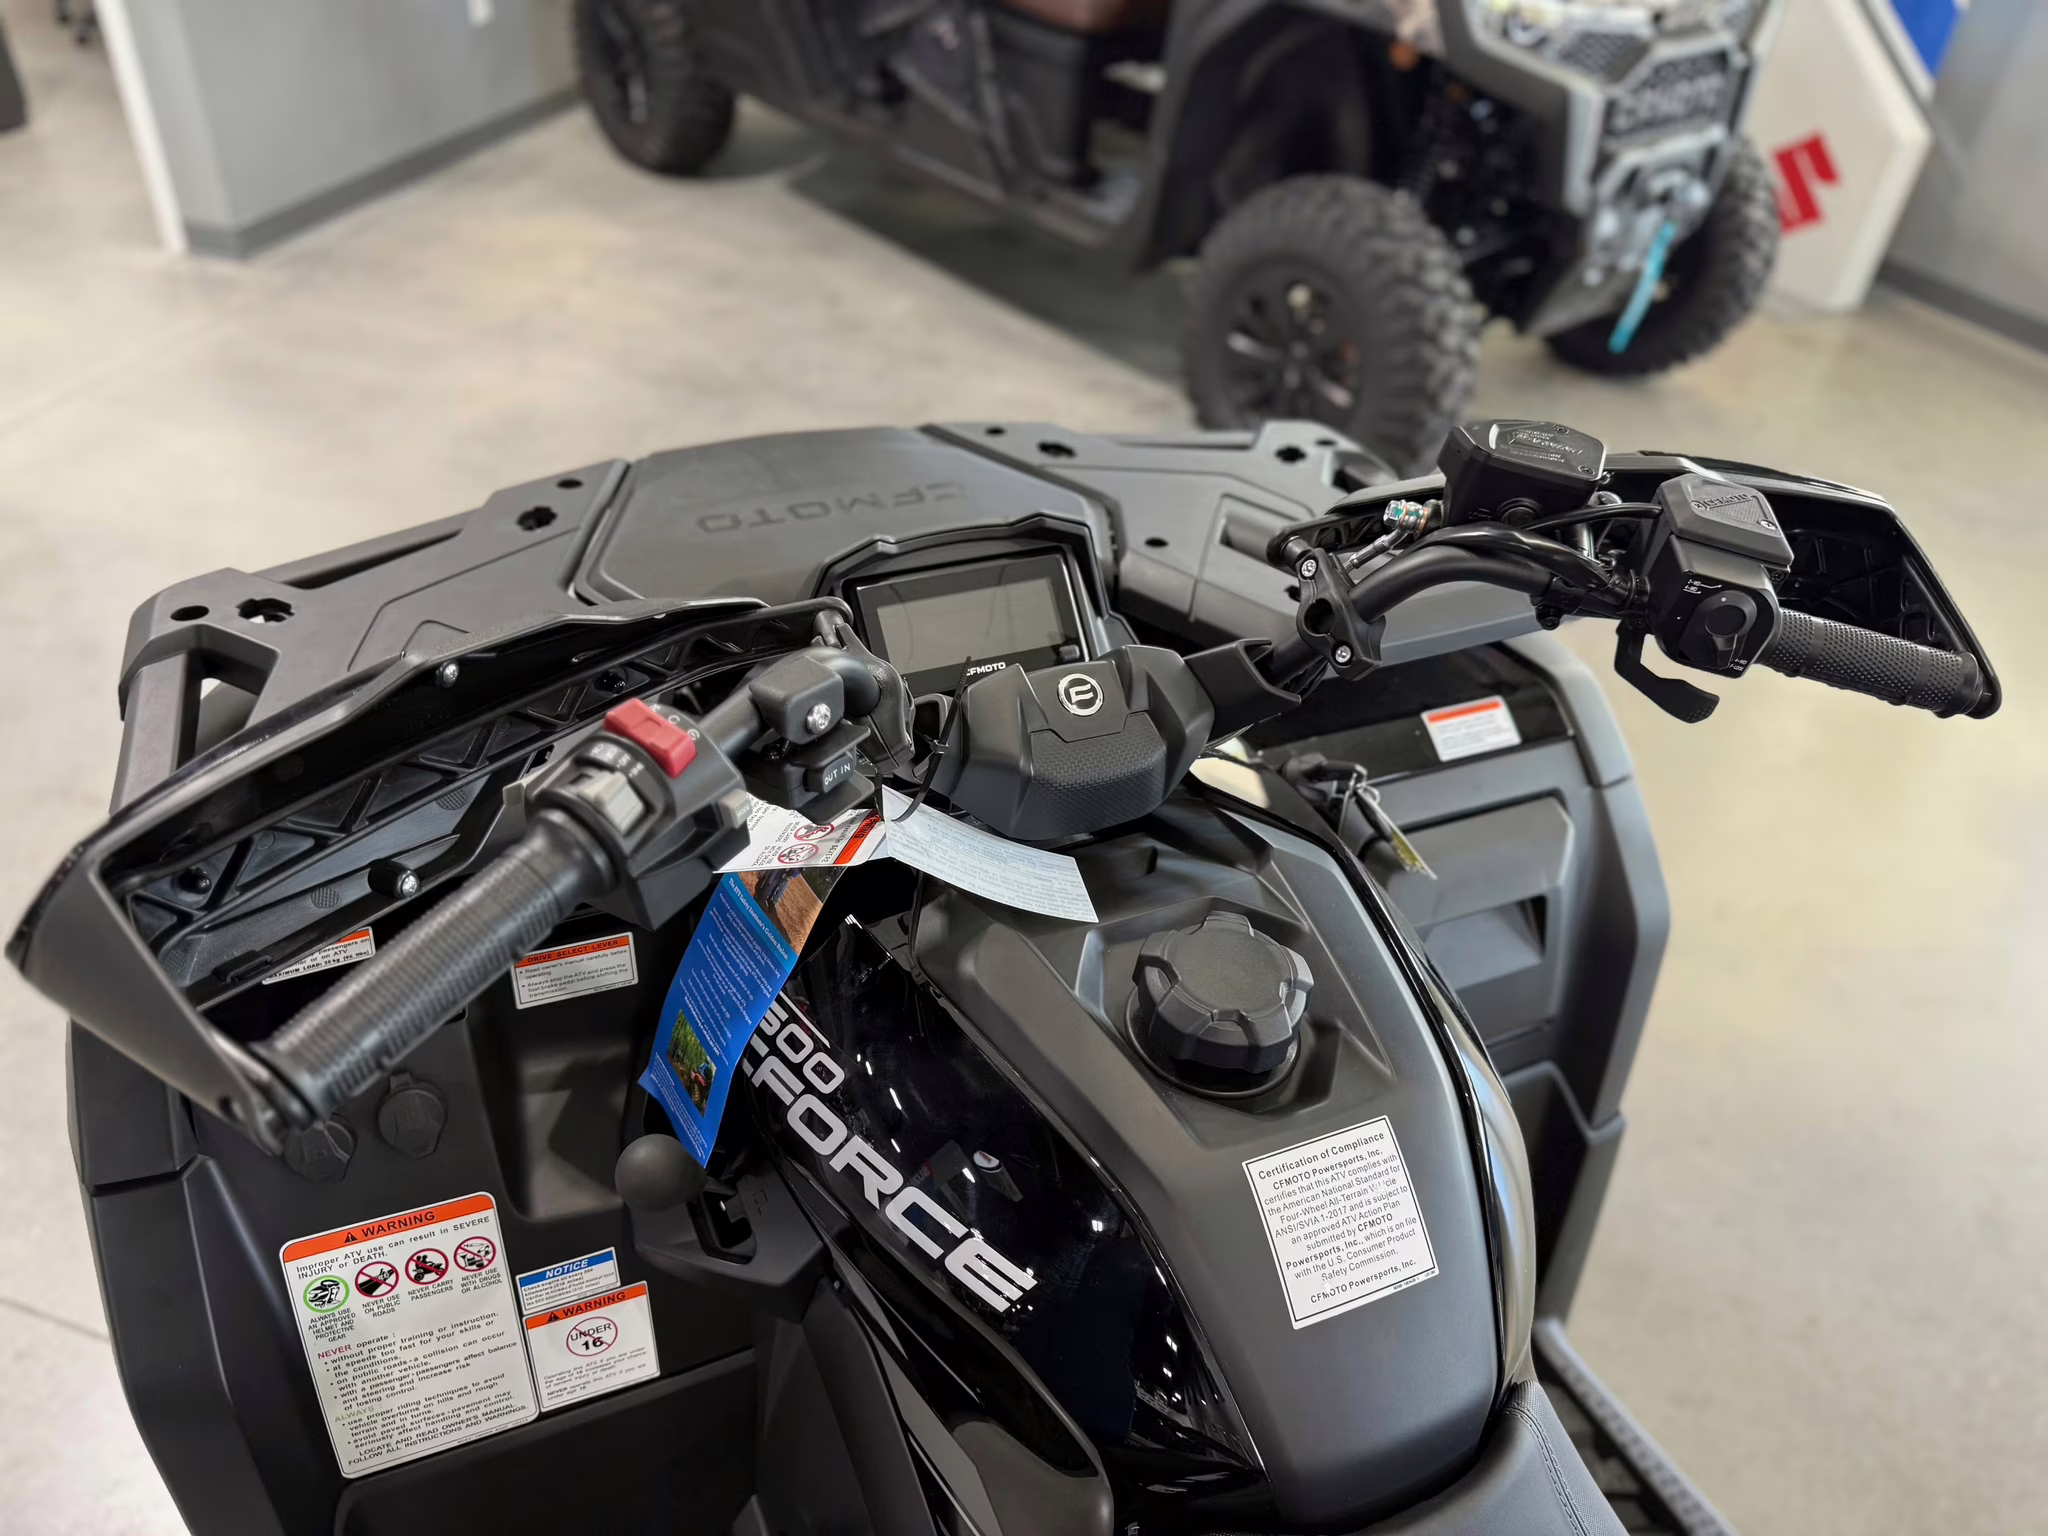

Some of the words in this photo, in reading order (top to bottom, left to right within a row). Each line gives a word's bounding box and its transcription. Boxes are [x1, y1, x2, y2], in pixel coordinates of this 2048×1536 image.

[696, 481, 966, 534] CFMOTO
[824, 769, 838, 786] OUT
[840, 762, 851, 775] IN
[526, 951, 553, 964] DRIVE
[555, 943, 590, 958] SELECT
[591, 939, 619, 950] LEVER
[759, 1000, 845, 1095] 500
[1258, 1154, 1319, 1179] Certification
[1320, 1148, 1330, 1159] of
[1330, 1132, 1384, 1155] Compliance
[1263, 1188, 1297, 1205] certifies
[1297, 1181, 1314, 1193] that
[1314, 1177, 1330, 1188] this
[1330, 1169, 1345, 1183] ATV
[1347, 1159, 1381, 1176] complies
[1381, 1153, 1397, 1164] with
[1272, 1170, 1311, 1190] CFMOTO
[1311, 1154, 1367, 1177] Powersports,
[1366, 1148, 1382, 1158] Inc.
[1267, 1206, 1281, 1216] the
[1282, 1192, 1321, 1211] American
[1320, 1179, 1354, 1197] National
[1354, 1167, 1389, 1185] Standard
[1389, 1164, 1400, 1173] for
[1275, 1215, 1320, 1238] ANSI/SVIA
[1320, 1205, 1346, 1221] 1-2017
[1348, 1199, 1364, 1212] and
[1364, 1198, 1372, 1206] is
[1372, 1187, 1400, 1203] subject
[1399, 1185, 1408, 1193] to
[1279, 1199, 1328, 1225] Four-Wheel
[1326, 1185, 1369, 1208] All-Terrain
[361, 1211, 435, 1237] WARNING
[1290, 1235, 1302, 1244] an
[1302, 1219, 1341, 1240] approved
[1341, 1213, 1356, 1226] ATV
[1358, 1206, 1382, 1220] Action
[1382, 1199, 1400, 1211] Plan
[1306, 1230, 1346, 1251] submitted
[1345, 1227, 1355, 1236] by
[1357, 1212, 1392, 1232] CFMOTO
[296, 1256, 338, 1272] Improper
[343, 1249, 361, 1260] ATV
[366, 1245, 383, 1253] use
[388, 1239, 404, 1248] can
[409, 1230, 435, 1242] result
[452, 1215, 490, 1231] SEVERE
[1285, 1245, 1344, 1270] Powersports,
[1344, 1239, 1363, 1249] Inc.,
[1363, 1228, 1386, 1241] which
[1387, 1225, 1394, 1233] is
[1394, 1221, 1404, 1230] on
[1404, 1217, 1416, 1226] file
[1293, 1267, 1312, 1279] with
[1312, 1262, 1326, 1272] the
[1326, 1253, 1346, 1268] U.S.
[1345, 1238, 1387, 1261] Consumer
[1385, 1227, 1416, 1245] Product
[297, 1264, 332, 1279] INJURY
[461, 1271, 482, 1281] NEVER
[484, 1267, 497, 1275] USE
[545, 1258, 589, 1280] NOTICE
[1320, 1266, 1347, 1281] Safety
[1348, 1248, 1398, 1271] Commission.
[1348, 1265, 1401, 1289] Powersports,
[1401, 1259, 1416, 1268] Inc.
[407, 1285, 429, 1295] NEVER
[431, 1278, 453, 1289] CARRY
[410, 1284, 453, 1301] PASSENGERS
[460, 1279, 477, 1288] WITH
[478, 1272, 501, 1283] DRUGS
[460, 1286, 471, 1294] OR
[473, 1278, 502, 1290] ALCOHOL
[361, 1297, 384, 1308] NEVER
[386, 1293, 399, 1302] USE
[364, 1306, 374, 1314] ON
[376, 1299, 400, 1310] PUBLIC
[372, 1307, 395, 1317] ROADS
[562, 1290, 625, 1317] WARNING
[308, 1323, 317, 1331] AN
[320, 1312, 356, 1327] APPROVED
[310, 1311, 336, 1324] ALWAYS
[337, 1307, 350, 1315] USE
[312, 1323, 337, 1335] HELMET
[340, 1318, 354, 1327] AND
[315, 1324, 354, 1340] PROTECTIVE
[327, 1333, 346, 1342] GEAR
[570, 1322, 613, 1342] UNDER
[581, 1336, 604, 1351] 16
[317, 1343, 352, 1359] NEVER
[330, 1349, 363, 1364] without
[367, 1341, 395, 1354] proper
[400, 1330, 433, 1343] training
[332, 1363, 341, 1371] at
[345, 1354, 376, 1367] speeds
[399, 1342, 415, 1351] fast
[419, 1337, 431, 1345] for
[435, 1331, 454, 1342] your
[459, 1323, 481, 1333] skills
[336, 1377, 348, 1385] on
[351, 1368, 379, 1381] public
[422, 1345, 458, 1359] collision
[462, 1339, 478, 1347] can
[481, 1331, 504, 1341] occur
[334, 1370, 348, 1378] the
[337, 1381, 357, 1391] with
[361, 1371, 393, 1384] another
[339, 1388, 357, 1398] with
[463, 1350, 484, 1361] affect
[487, 1341, 517, 1353] balance
[342, 1394, 358, 1405] and
[361, 1385, 395, 1398] steering
[399, 1378, 414, 1387] and
[417, 1368, 452, 1381] increase
[455, 1362, 470, 1370] risk
[343, 1403, 352, 1411] of
[355, 1395, 382, 1407] losing
[347, 1450, 383, 1465] FOLLOW
[385, 1445, 401, 1453] ALL
[404, 1425, 462, 1447] INSTRUCTIONS
[464, 1419, 482, 1428] AND
[358, 1441, 391, 1456] LOCATE
[394, 1435, 412, 1445] AND
[415, 1427, 438, 1438] READ
[441, 1414, 478, 1430] OWNER'S
